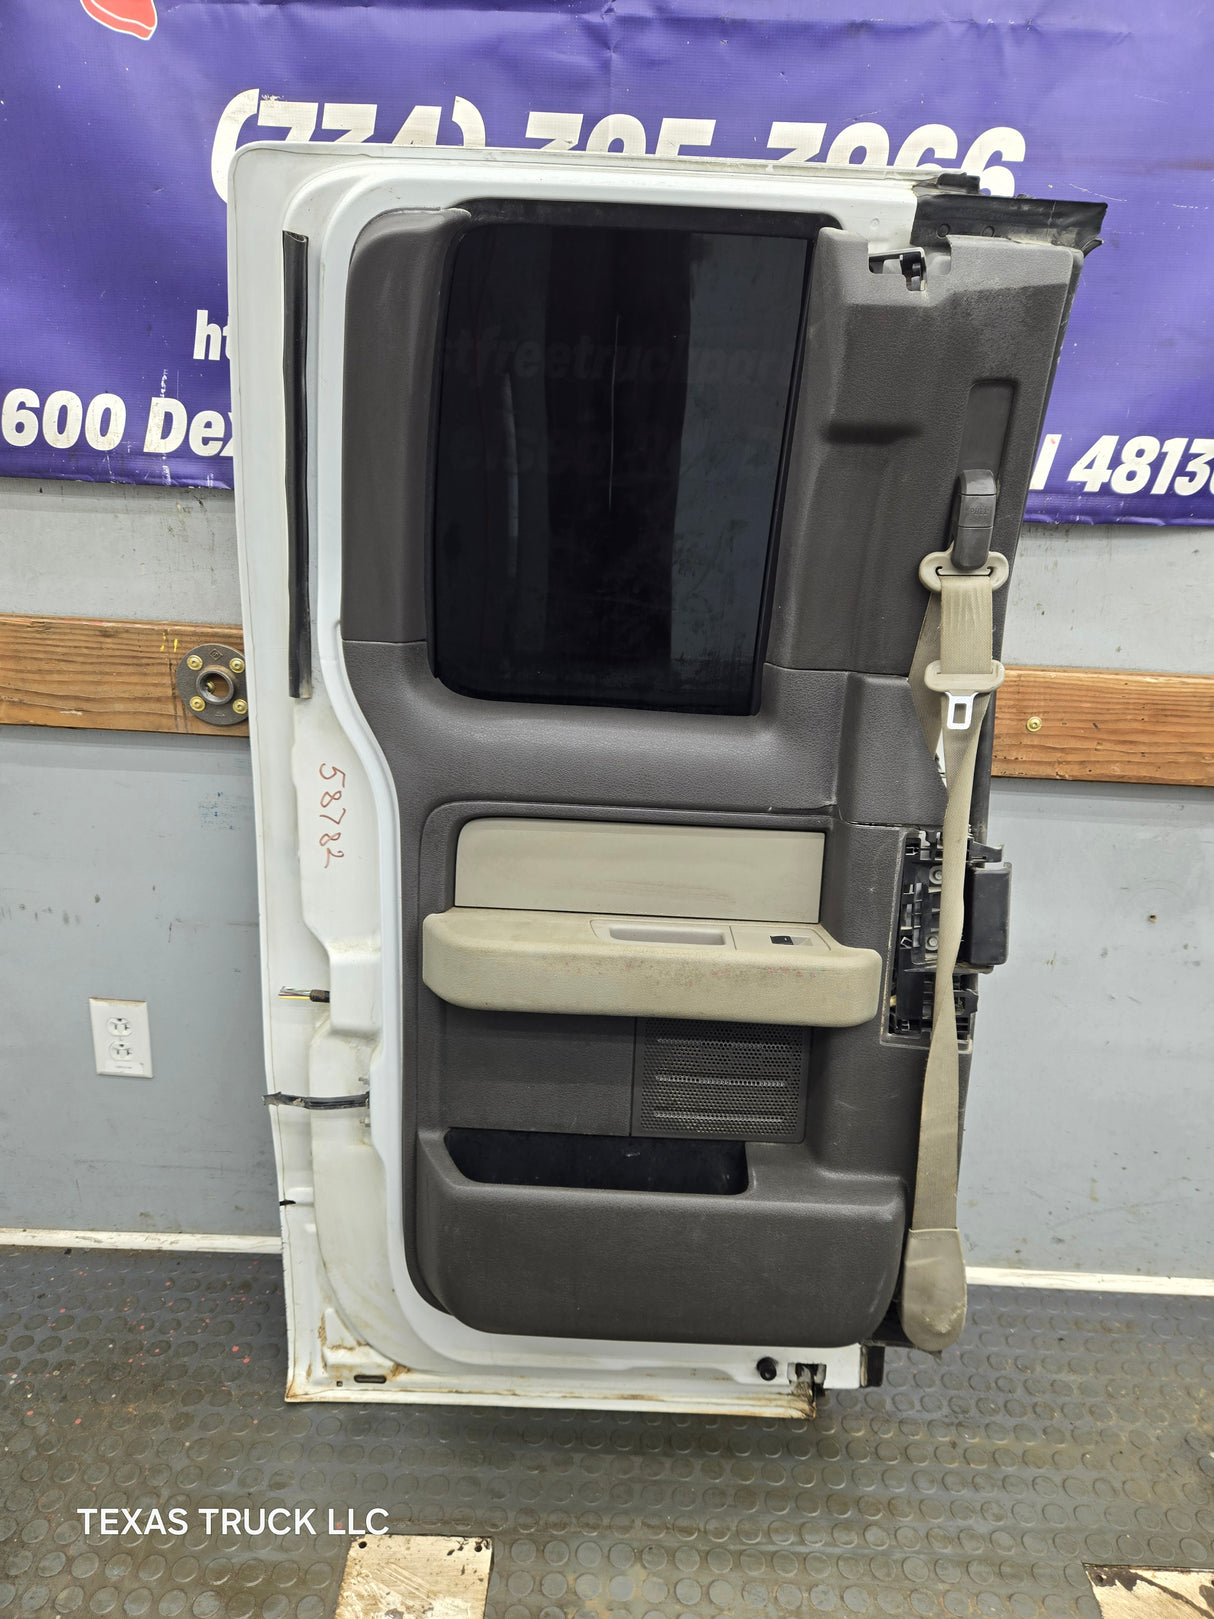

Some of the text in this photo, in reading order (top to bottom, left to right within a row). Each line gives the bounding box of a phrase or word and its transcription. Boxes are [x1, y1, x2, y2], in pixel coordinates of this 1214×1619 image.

[2, 388, 127, 451] 600
[1067, 434, 1214, 496] 4813
[319, 763, 346, 869] 58782
